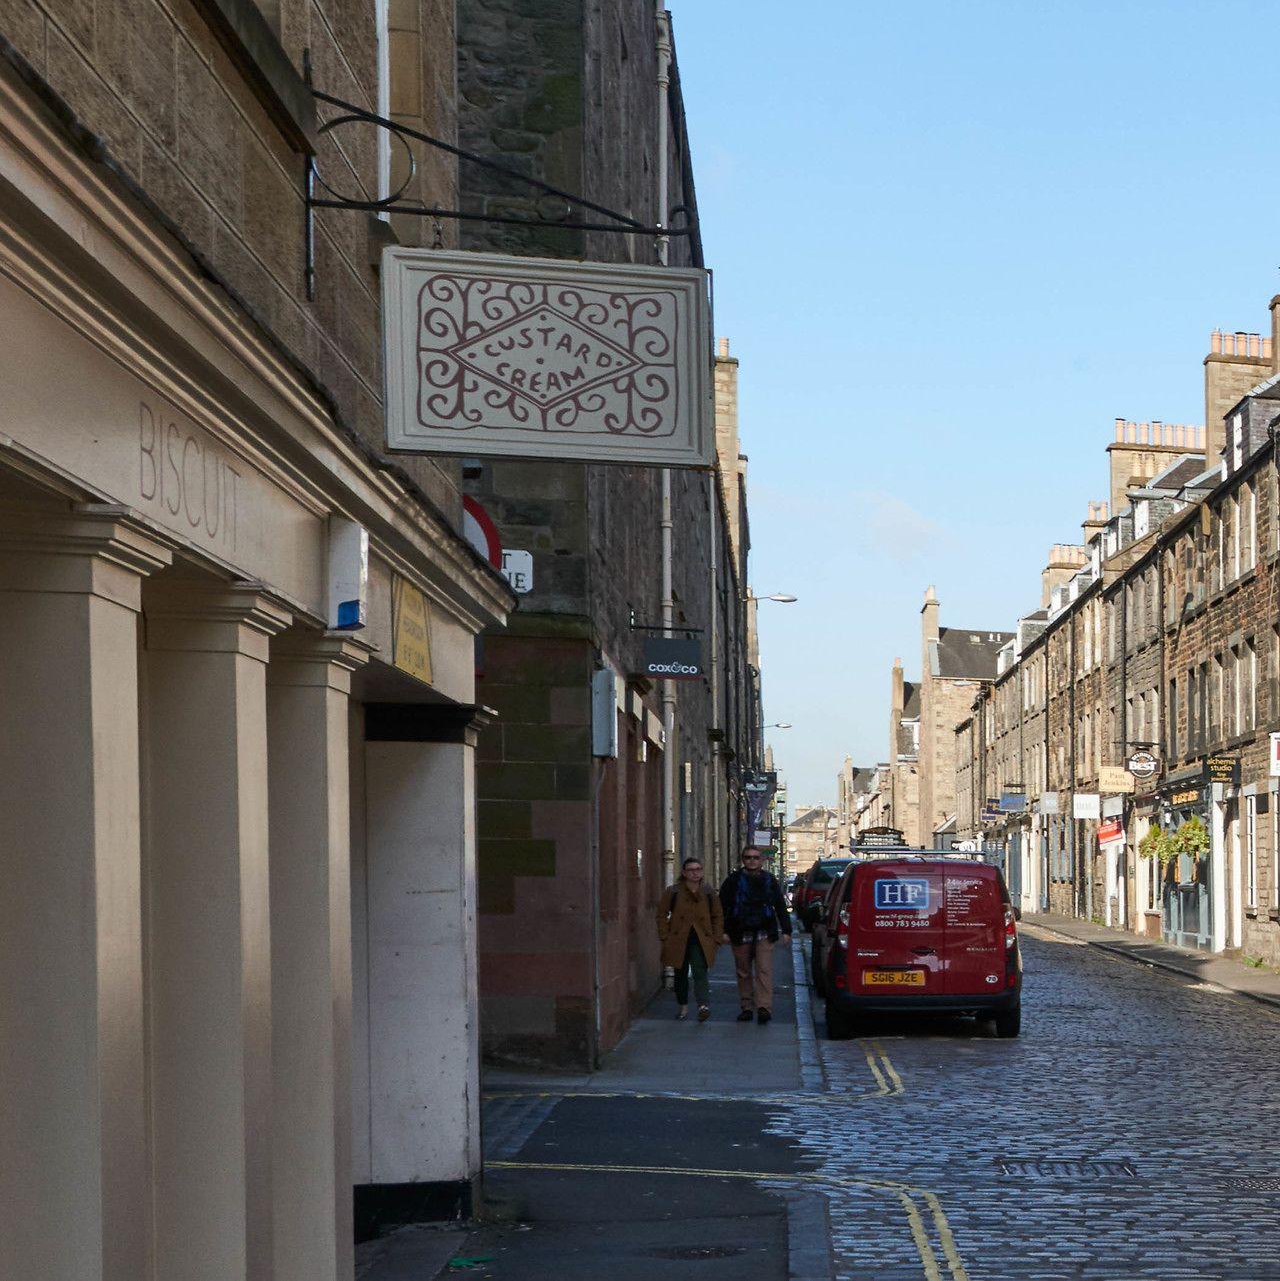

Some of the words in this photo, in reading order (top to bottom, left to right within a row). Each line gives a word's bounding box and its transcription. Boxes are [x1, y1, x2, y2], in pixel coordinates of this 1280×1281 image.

[484, 327, 612, 367] CUSTARD
[497, 362, 585, 392] CREAM
[140, 401, 241, 551] BISCUIT
[882, 884, 923, 903] HF
[871, 973, 895, 983] SG16
[898, 973, 918, 983] JZE
